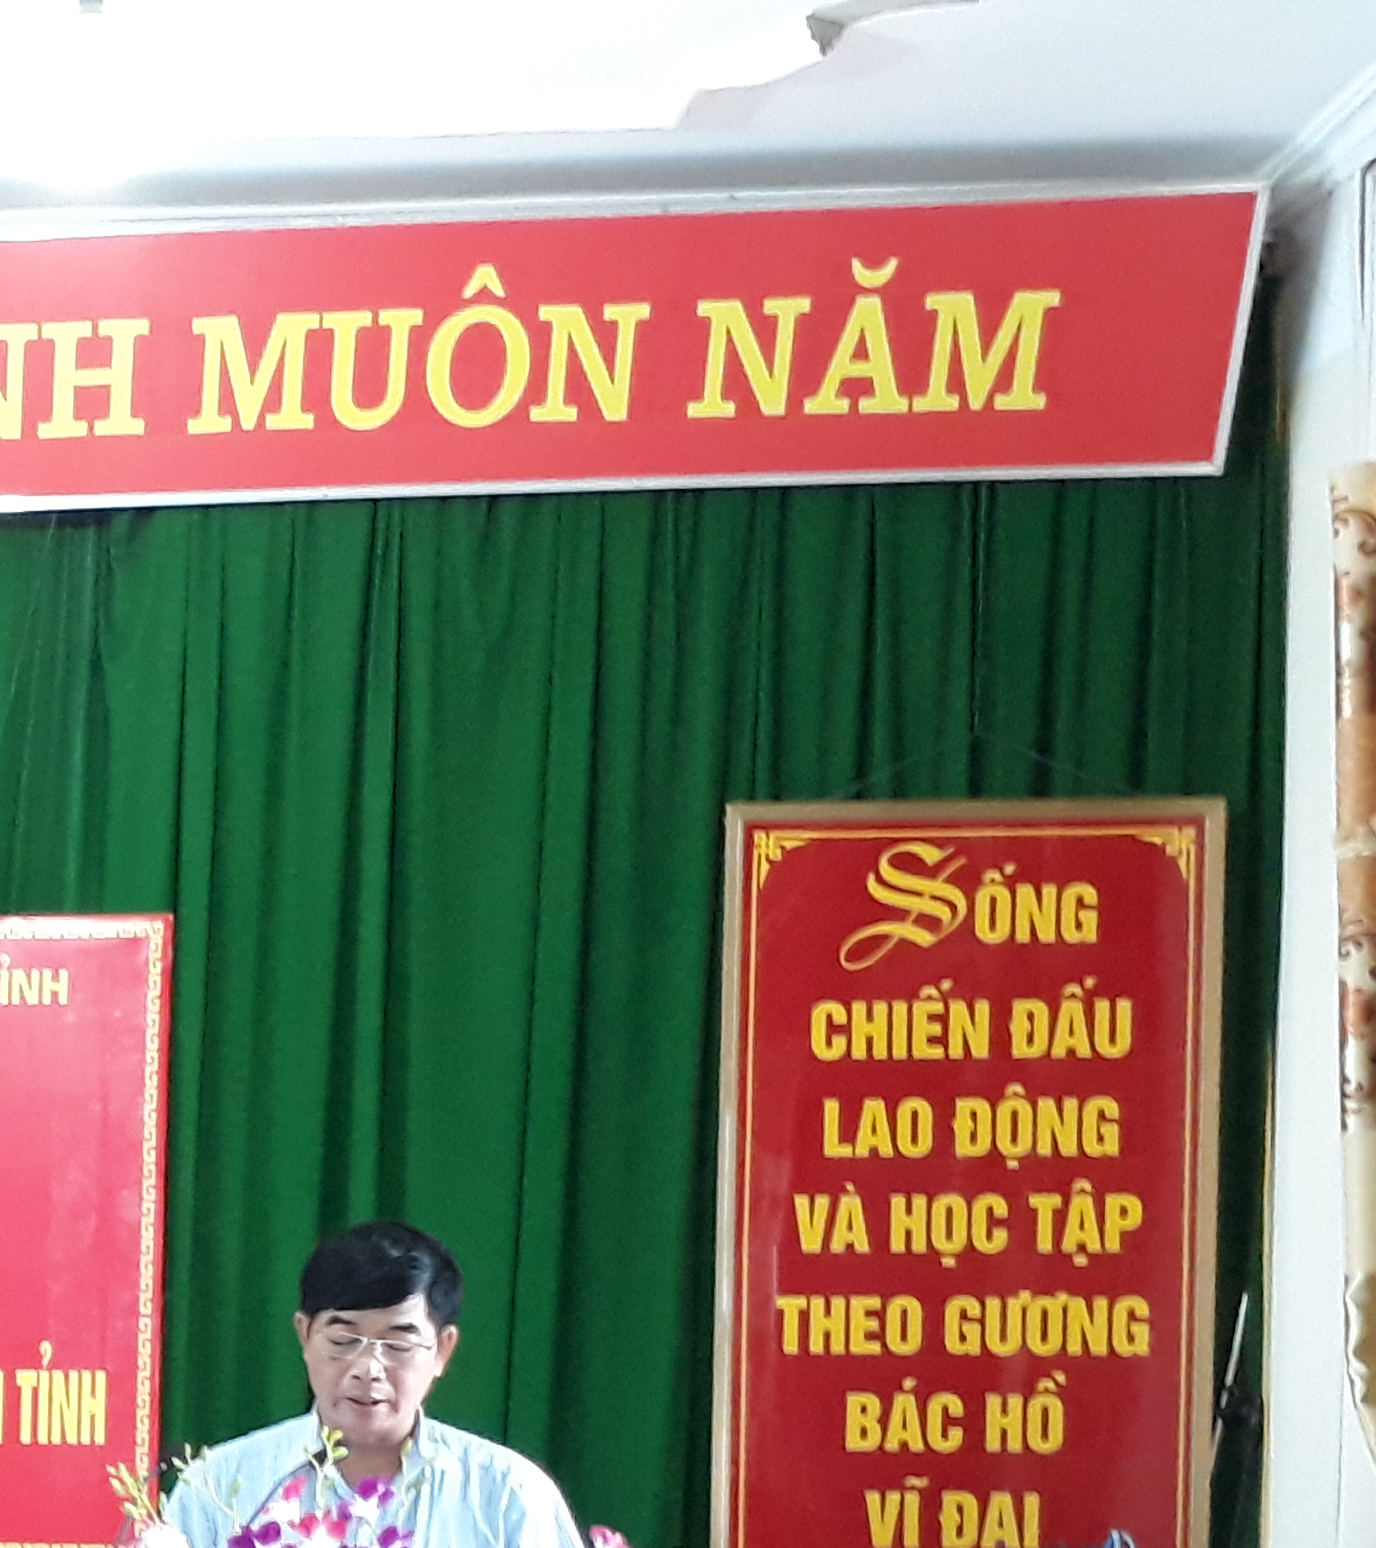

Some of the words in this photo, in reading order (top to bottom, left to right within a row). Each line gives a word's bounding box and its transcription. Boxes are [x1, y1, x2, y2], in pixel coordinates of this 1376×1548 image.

[187, 264, 652, 435] MUÔN
[685, 258, 1062, 419] NĂM
[841, 841, 1099, 971] SỐNG
[810, 980, 991, 1062] CHIẾN
[1009, 976, 1133, 1059] ĐẤU
[823, 1096, 934, 1159] LAO
[951, 1083, 1120, 1169] ĐỘNG
[793, 1183, 871, 1254] VÀ
[889, 1193, 1009, 1268] HỌC
[1028, 1178, 1143, 1267] TẬP
[775, 1294, 923, 1356] THEO
[944, 1289, 1151, 1358] GƯƠNG
[15, 1340, 107, 1446] TỈNH
[845, 1378, 965, 1454] BÁC
[985, 1370, 1067, 1455] HỒ
